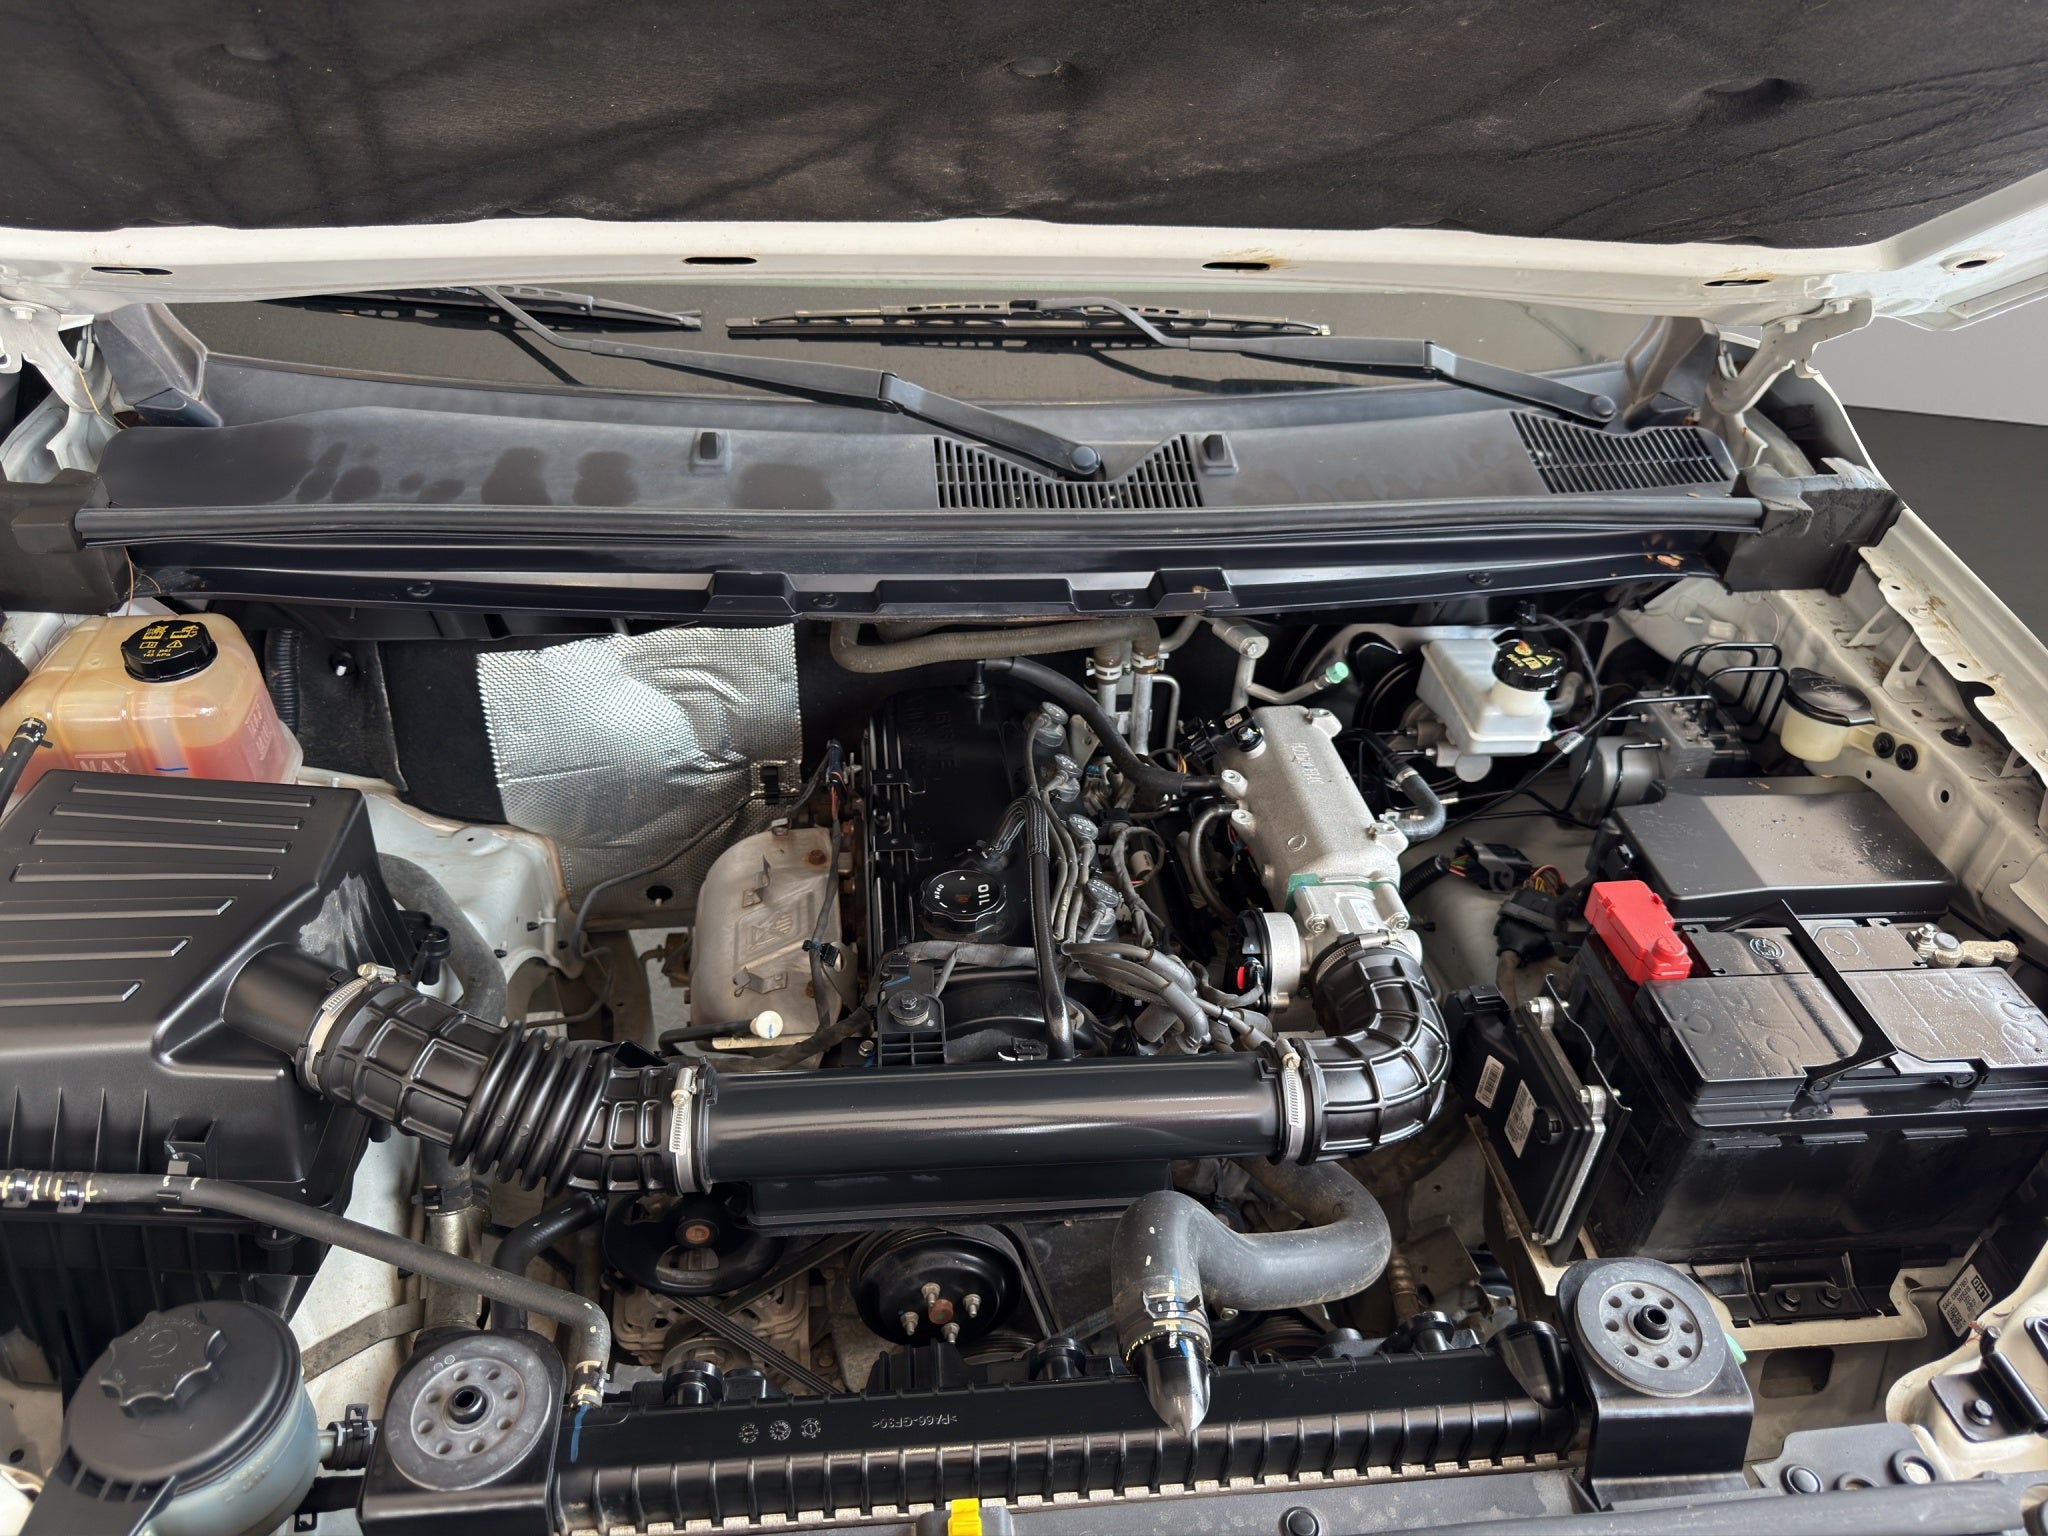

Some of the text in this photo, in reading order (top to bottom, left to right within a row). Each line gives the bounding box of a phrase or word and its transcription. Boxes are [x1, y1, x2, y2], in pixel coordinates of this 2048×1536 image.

[80, 760, 129, 773] MAX
[934, 884, 944, 900] OPEN
[978, 884, 990, 906] OIL
[1972, 1278, 1988, 1300] LHD
